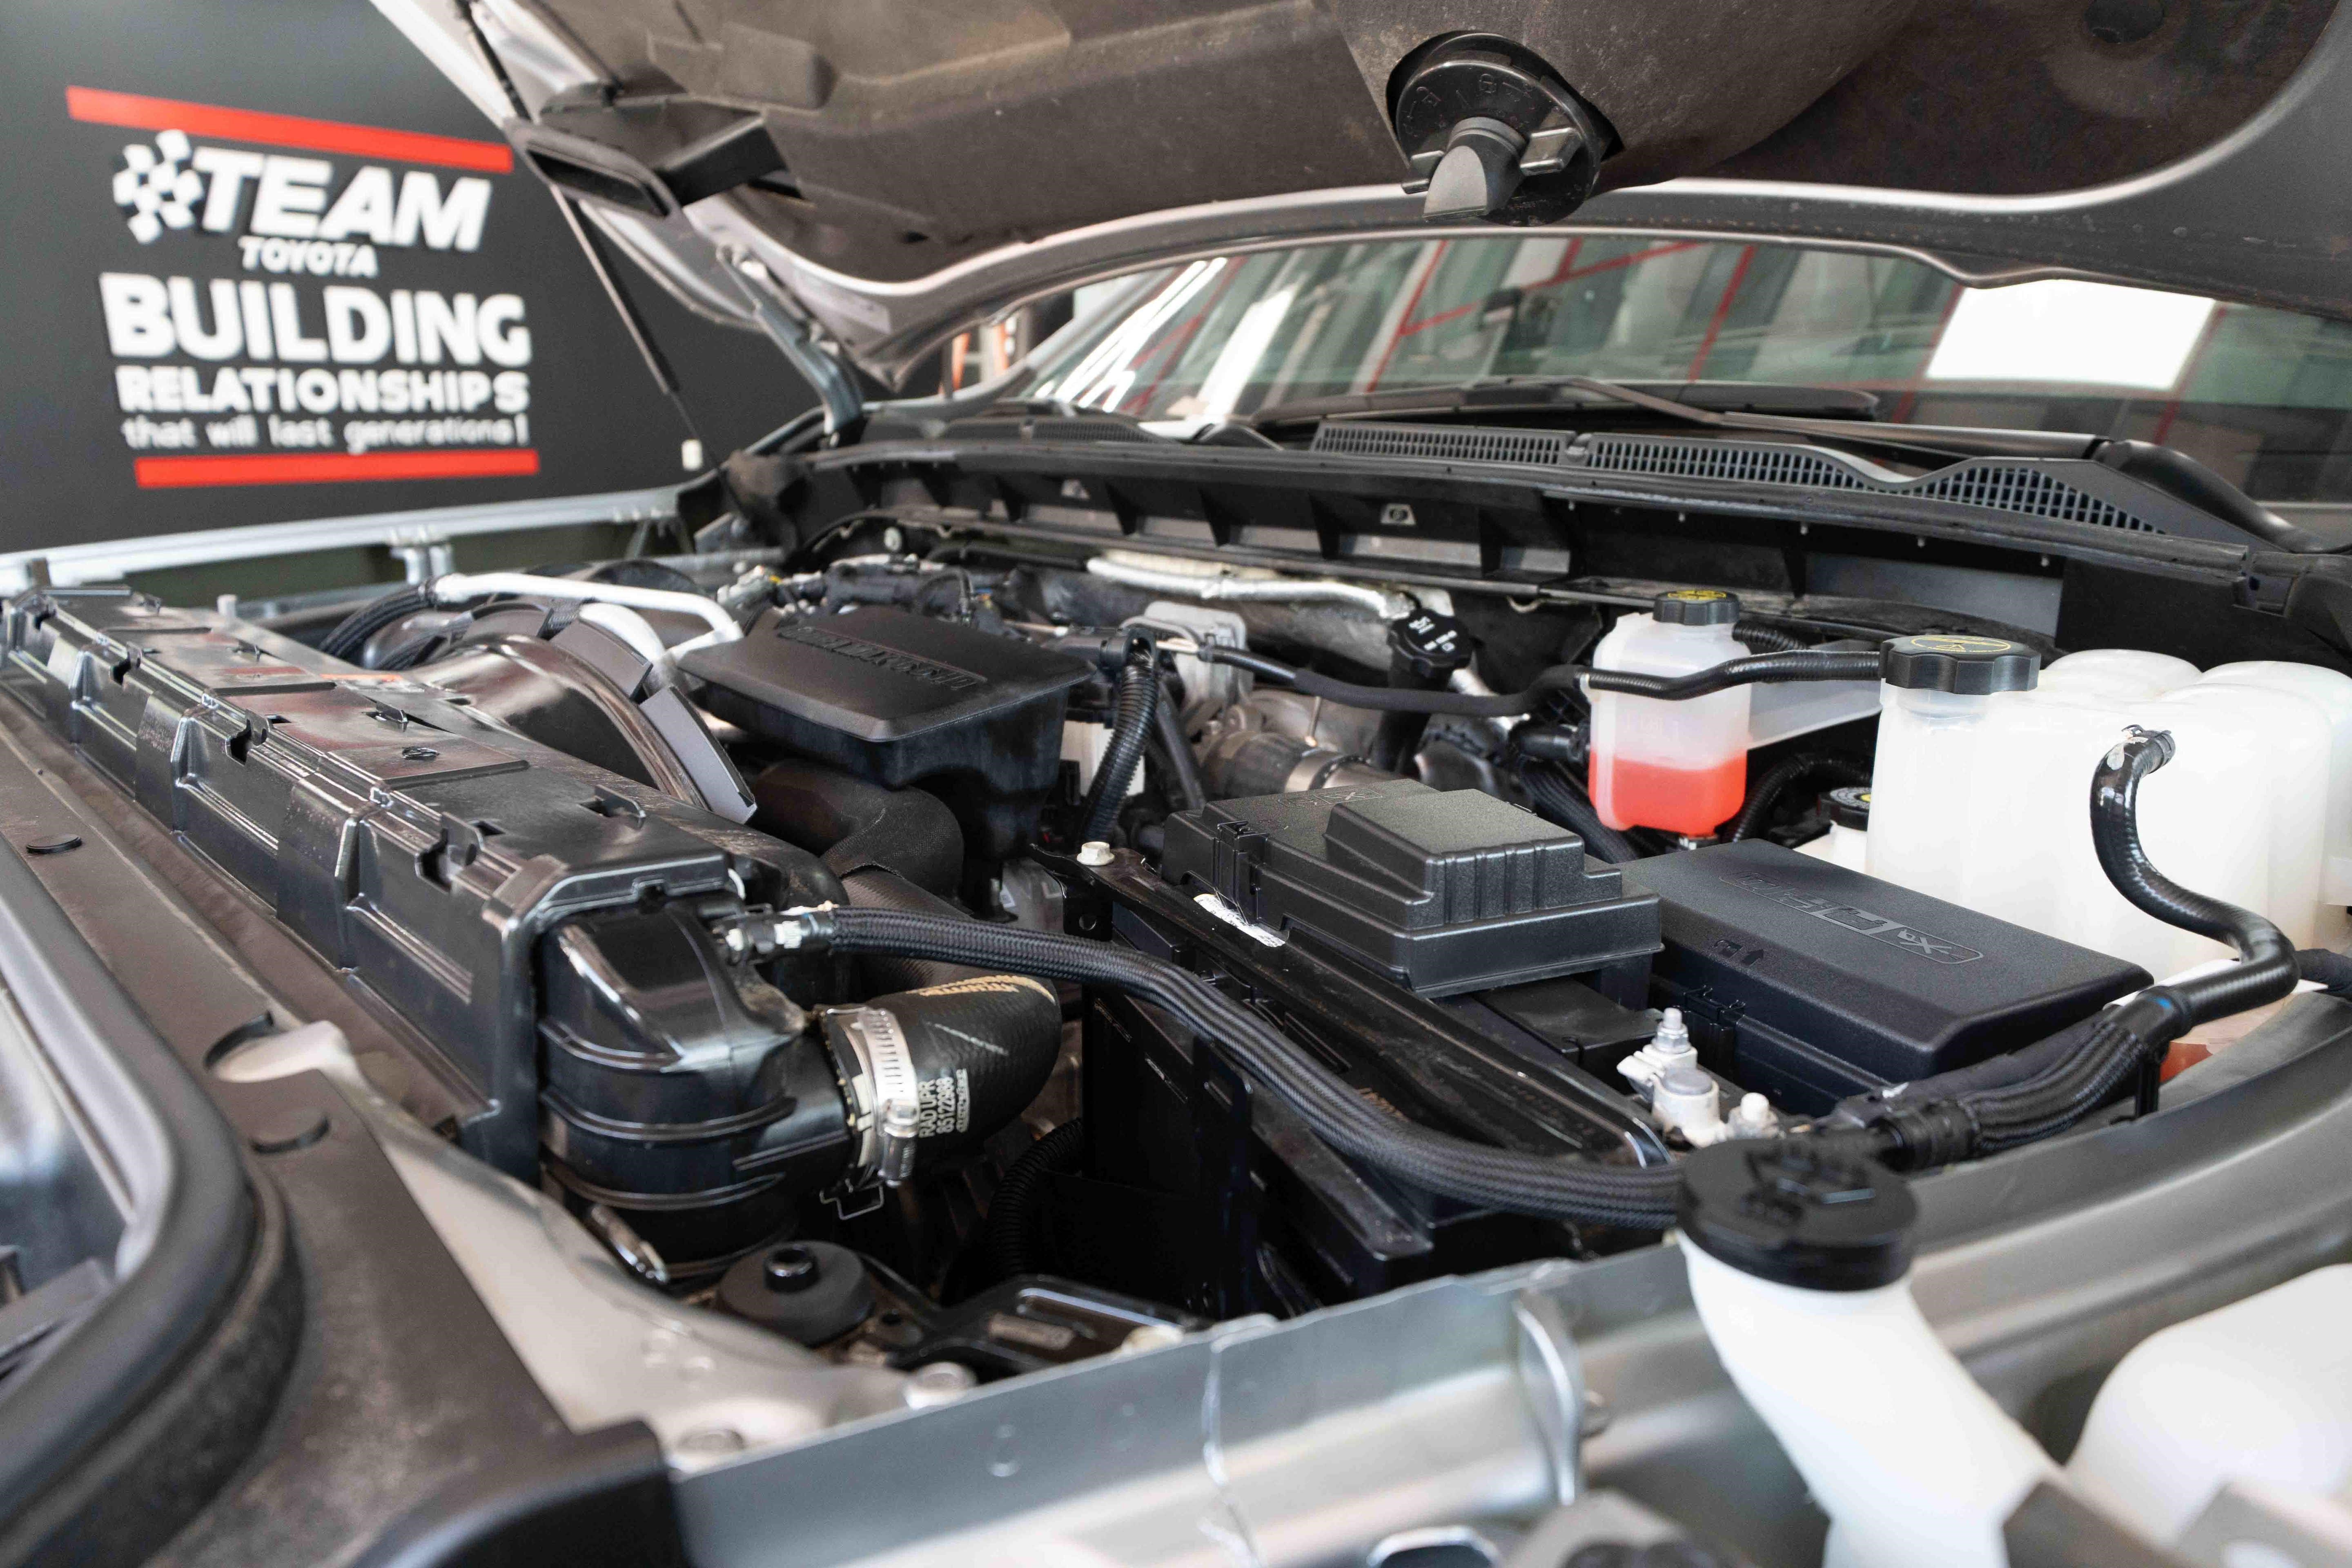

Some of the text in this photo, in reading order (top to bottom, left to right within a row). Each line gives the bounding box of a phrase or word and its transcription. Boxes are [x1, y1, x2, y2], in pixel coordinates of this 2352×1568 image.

[192, 146, 492, 252] TEAM
[238, 235, 378, 278] TOYOTA
[99, 272, 532, 367] BUILDING
[115, 365, 529, 413] RELATIONSHIPS
[121, 414, 196, 448] that
[205, 414, 258, 447] will
[267, 414, 333, 447] last
[919, 1080, 938, 1138] RAD UPR
